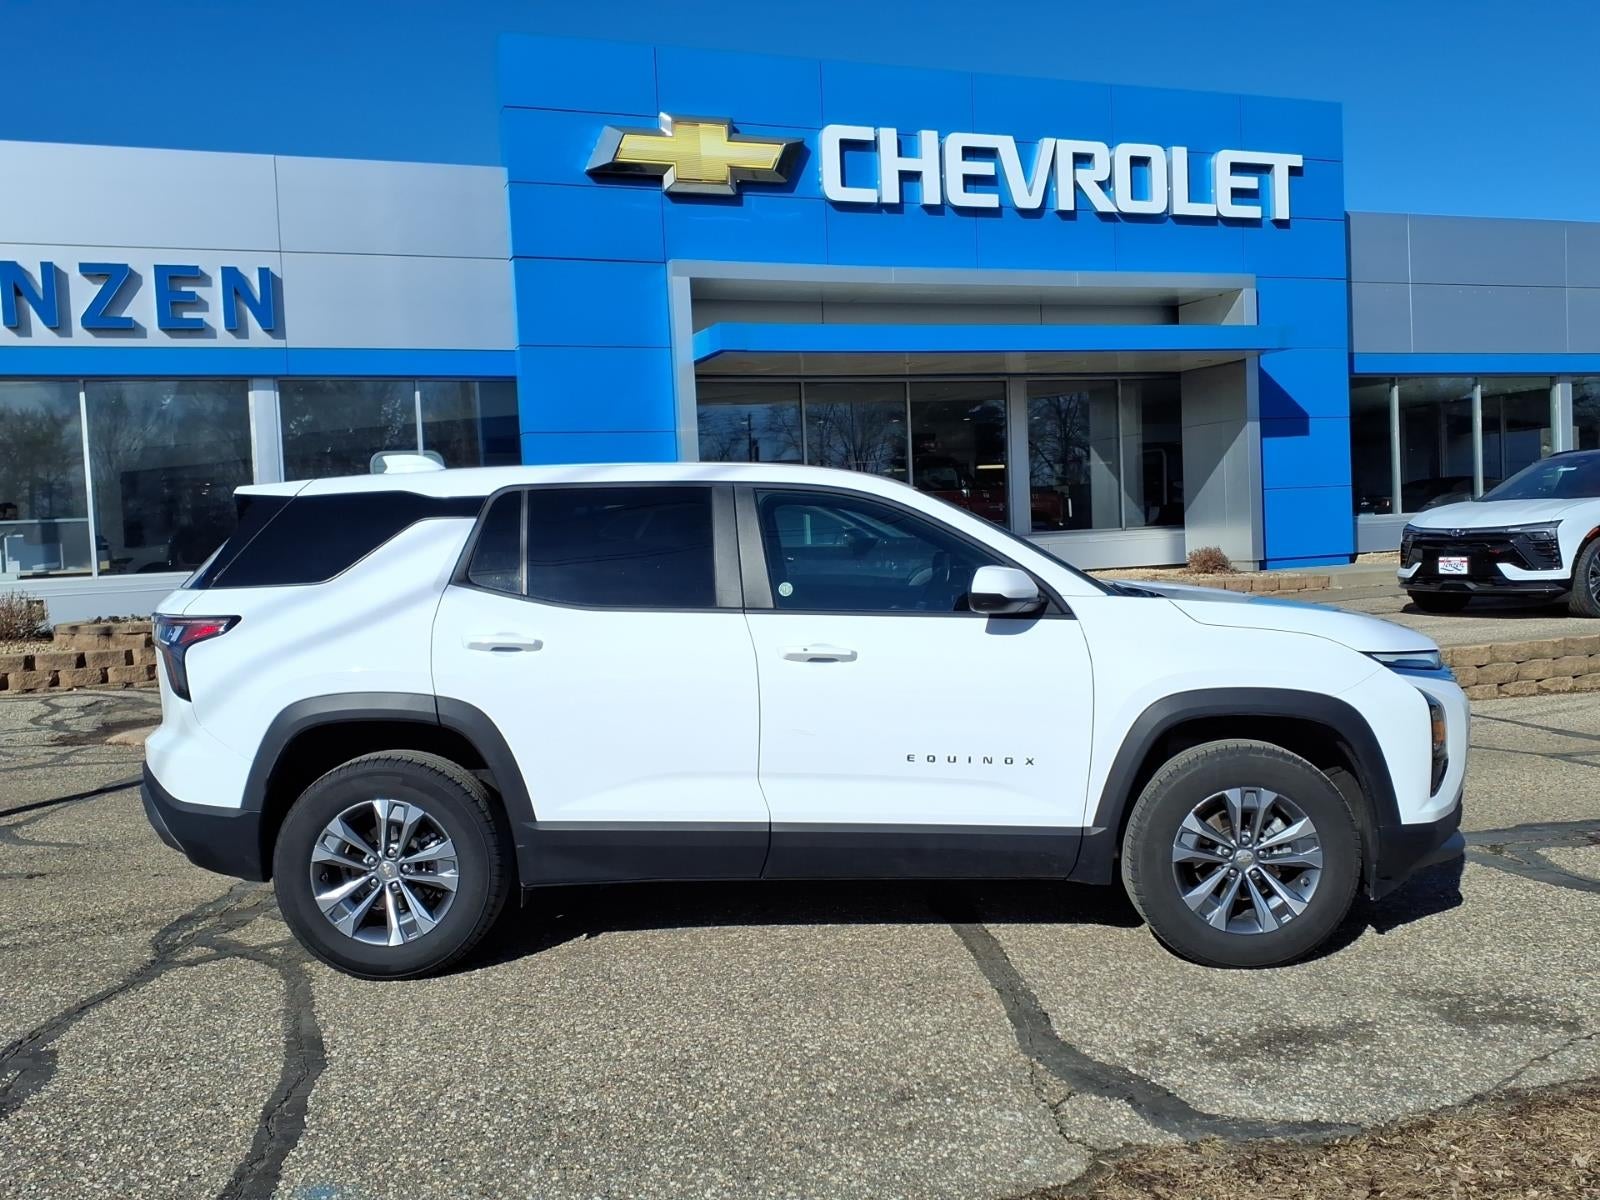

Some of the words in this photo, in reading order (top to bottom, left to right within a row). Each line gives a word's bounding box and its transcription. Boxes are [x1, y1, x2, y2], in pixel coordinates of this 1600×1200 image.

[820, 124, 1304, 220] CHEVROLET
[0, 260, 275, 331] NZEN
[906, 754, 1035, 766] EQUINOX
